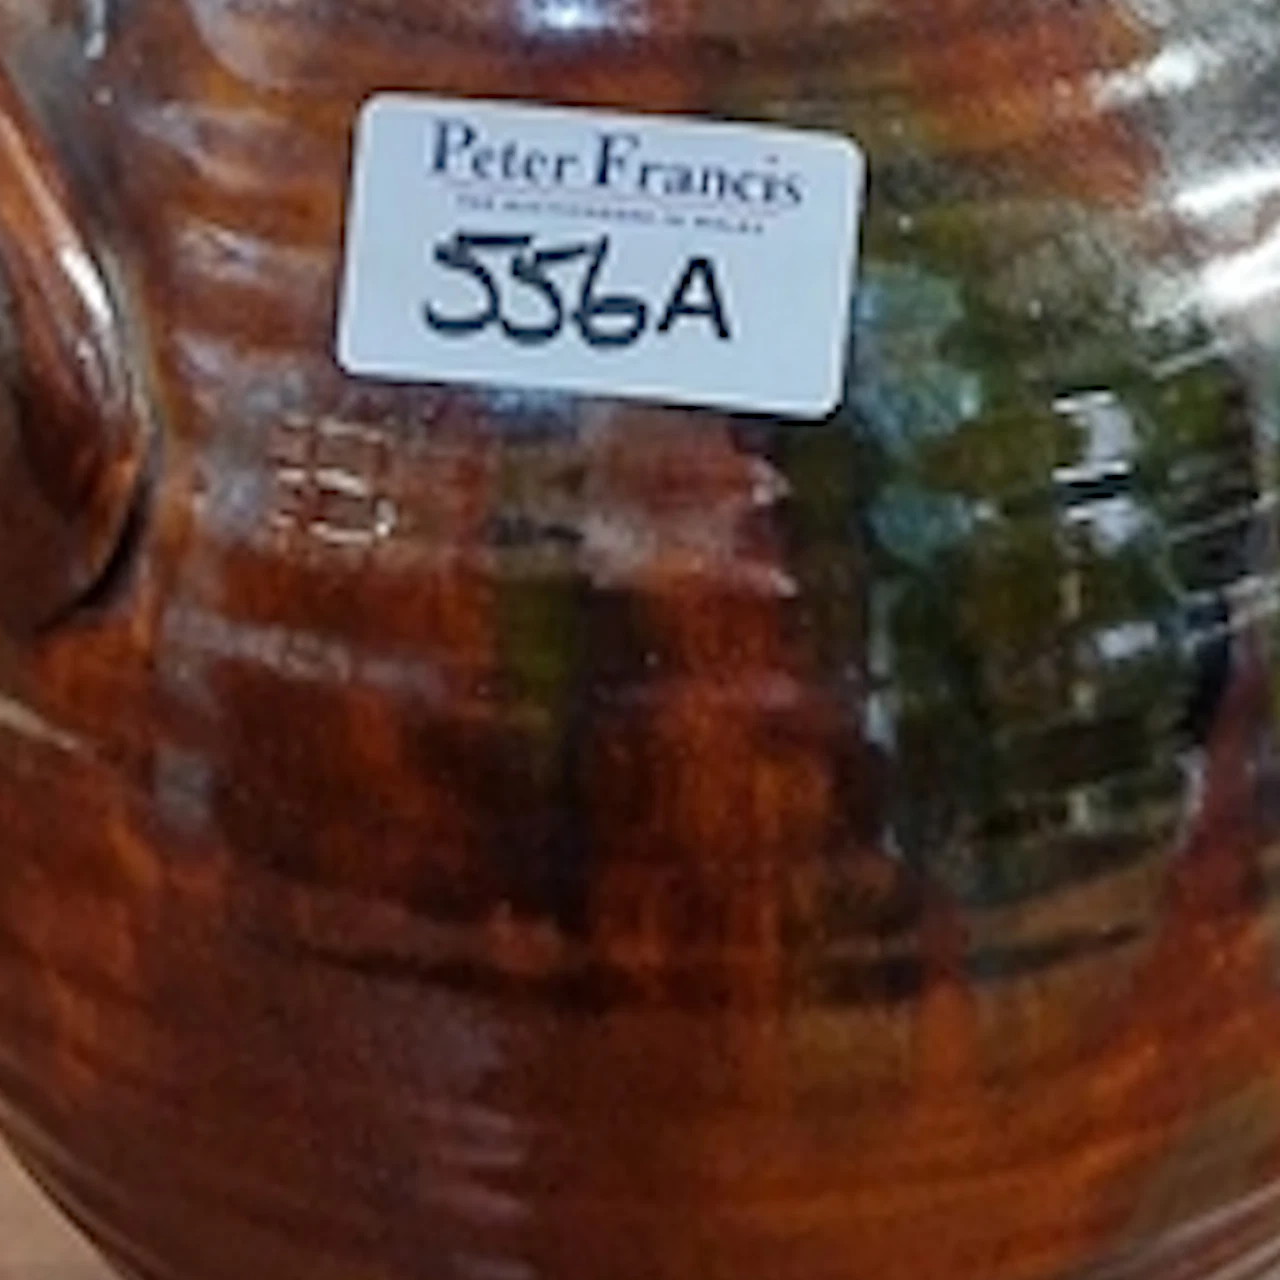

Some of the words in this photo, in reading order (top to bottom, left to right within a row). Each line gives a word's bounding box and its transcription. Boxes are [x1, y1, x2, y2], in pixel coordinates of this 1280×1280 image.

[429, 119, 580, 183] Peter
[594, 131, 805, 206] Francis
[425, 231, 732, 347] 556A
